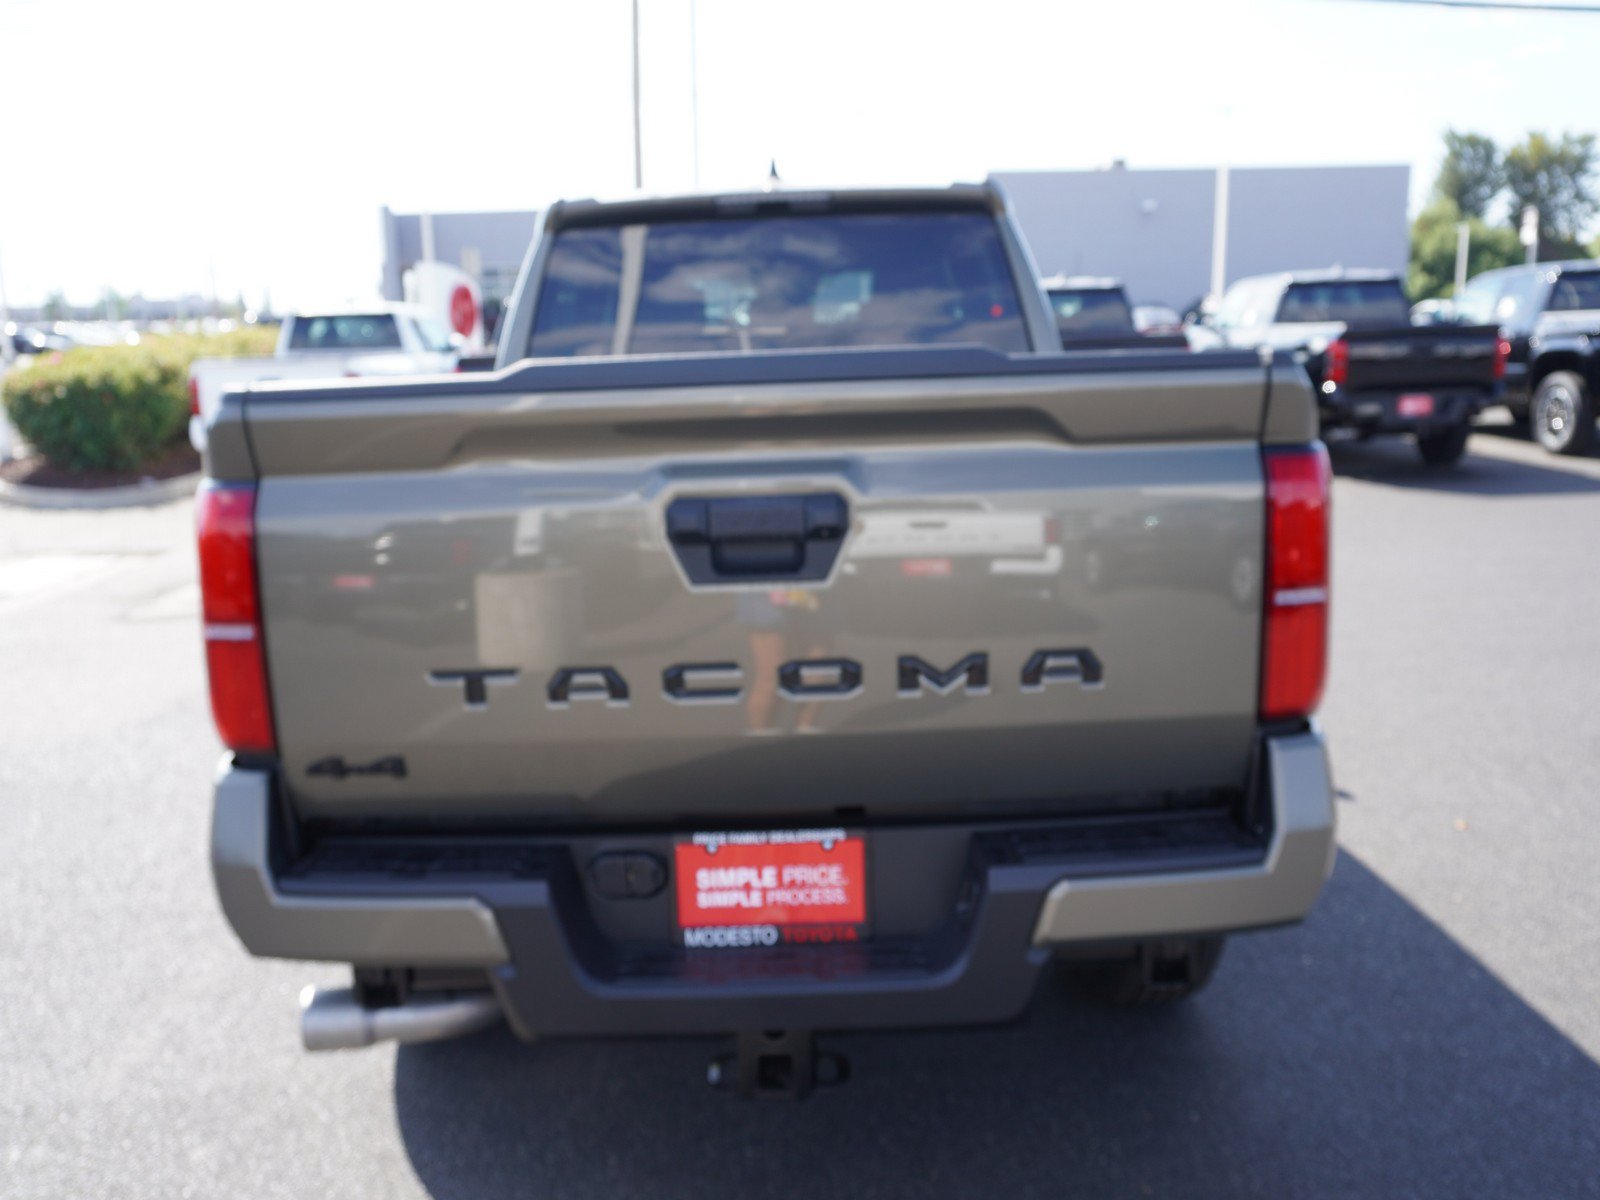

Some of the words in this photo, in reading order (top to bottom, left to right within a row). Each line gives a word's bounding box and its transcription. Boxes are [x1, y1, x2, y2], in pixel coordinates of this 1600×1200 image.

[426, 646, 1105, 711] TACOMA
[696, 867, 777, 888] SIMPLE
[696, 889, 762, 909] SIMPLE
[684, 926, 778, 947] MODESTO
[783, 927, 858, 943] TOYOTA
